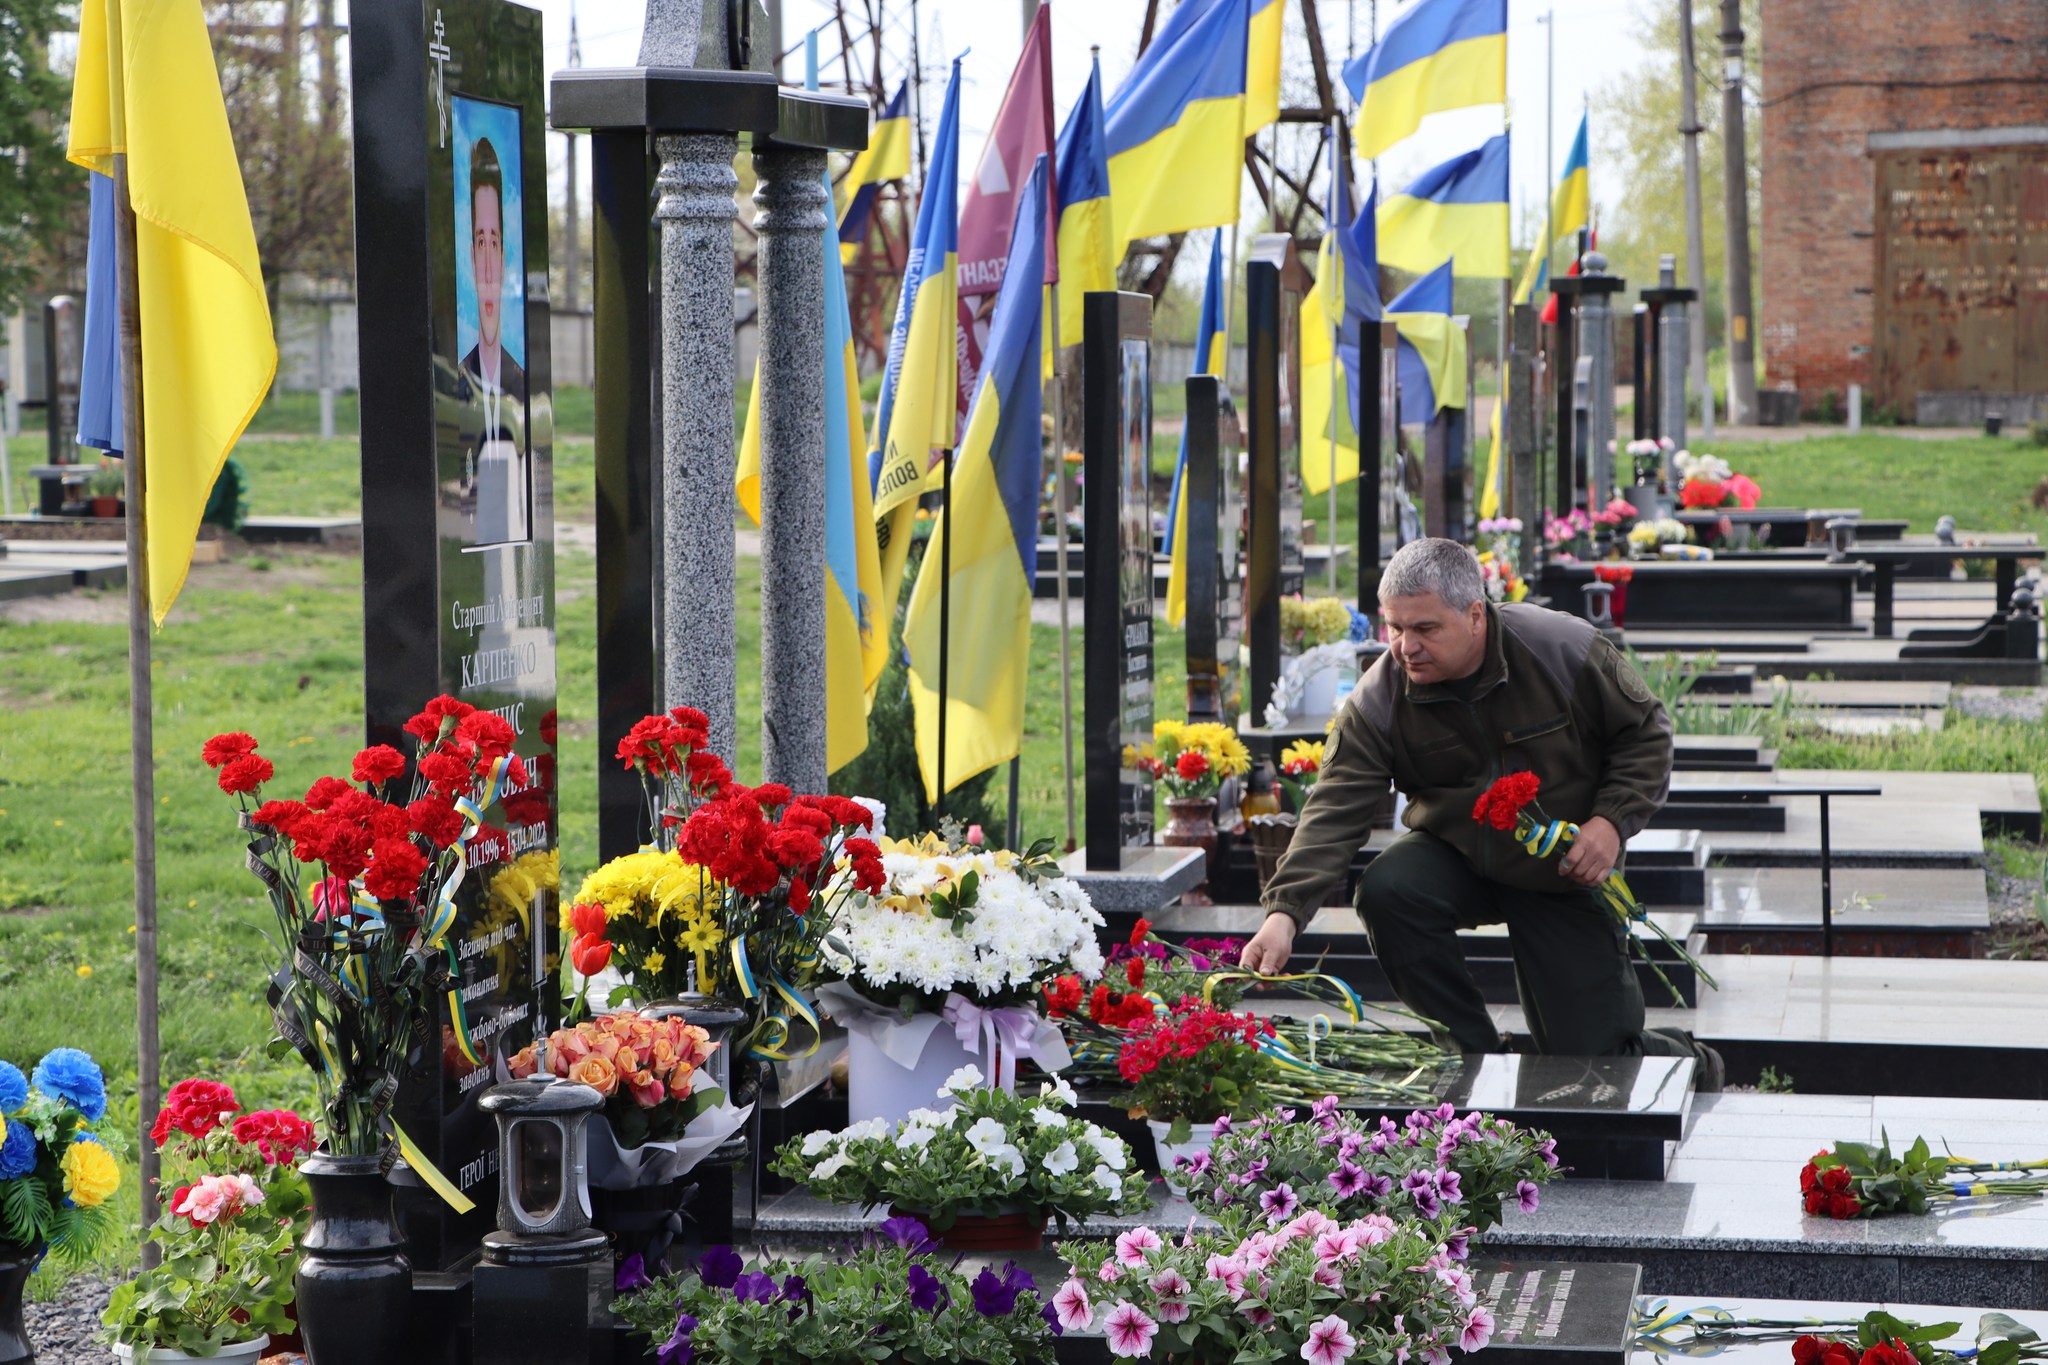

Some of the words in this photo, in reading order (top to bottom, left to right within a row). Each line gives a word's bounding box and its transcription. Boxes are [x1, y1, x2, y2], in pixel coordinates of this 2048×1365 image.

[452, 599, 496, 637] Старший
[461, 641, 537, 689] КАРПЕНКО
[466, 836, 500, 871] .10.1996
[506, 820, 547, 857] 15.04.2022
[458, 932, 490, 961] Загинув
[304, 963, 342, 1001] ПАМ'ЯТЬ
[460, 972, 500, 1004] иконання
[466, 1002, 530, 1043] жбово-бойових
[459, 1149, 486, 1192] ГЕРОЇ
